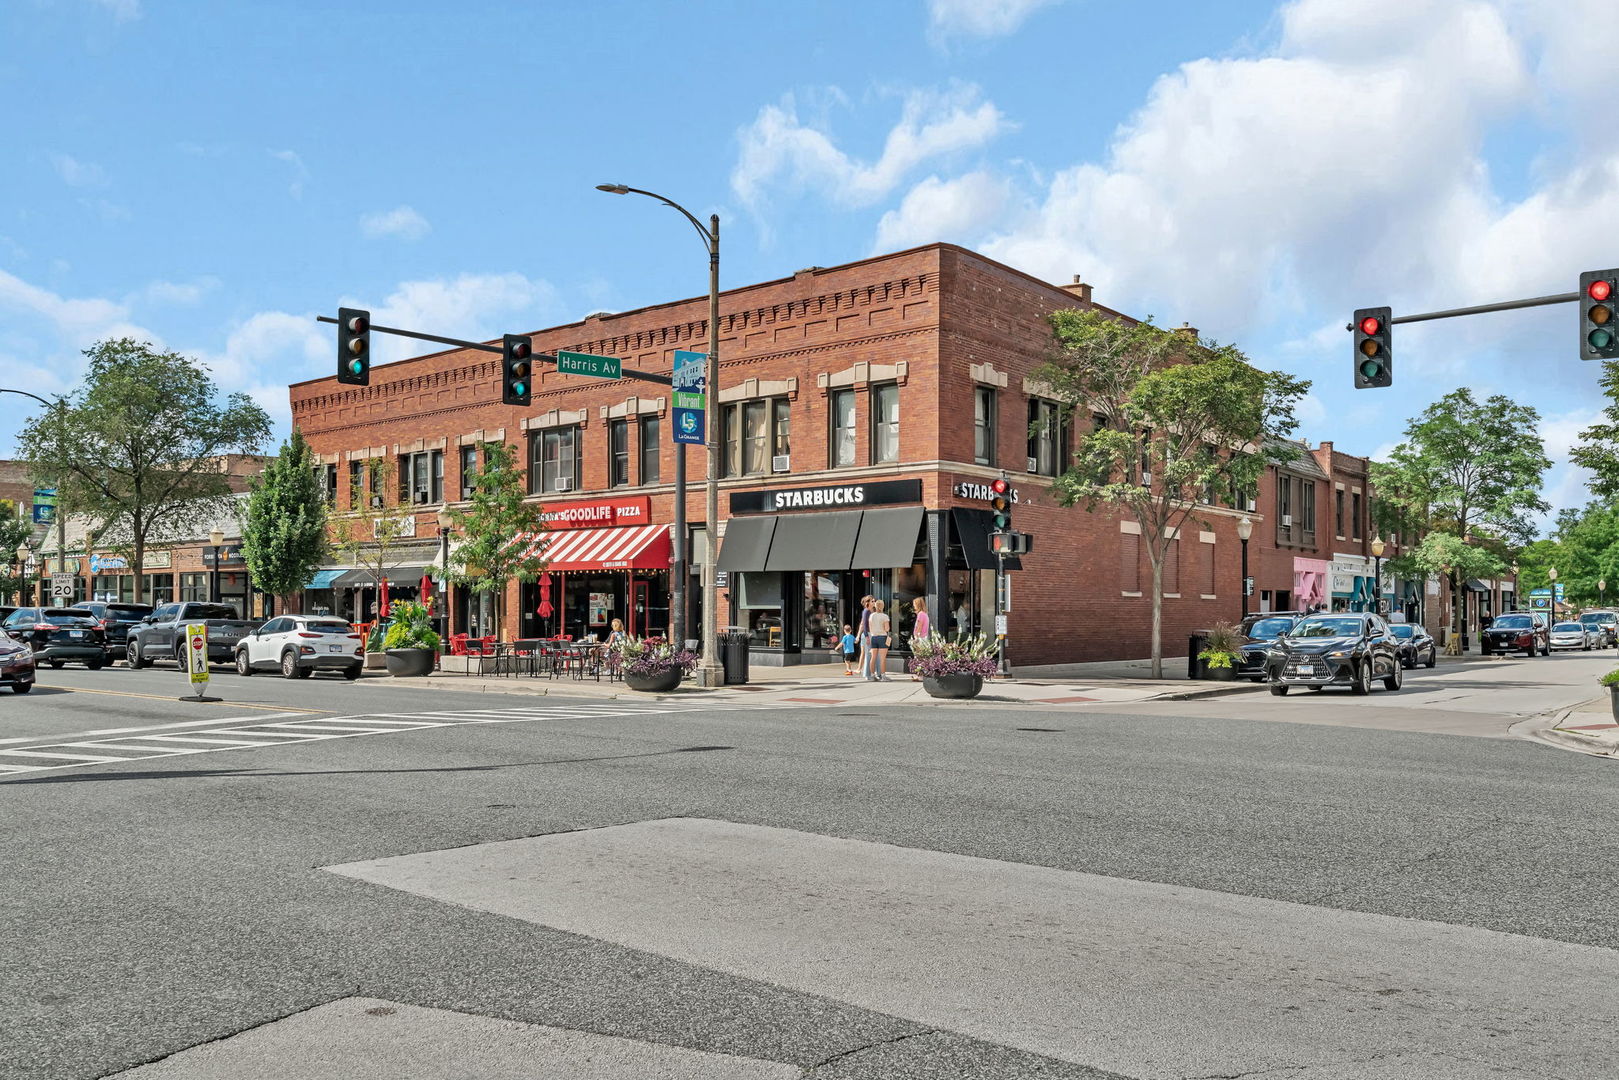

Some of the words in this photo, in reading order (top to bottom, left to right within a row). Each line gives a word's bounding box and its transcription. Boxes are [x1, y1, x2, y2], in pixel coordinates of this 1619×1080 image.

[562, 356, 597, 372] Harris
[602, 361, 617, 374] Av
[678, 393, 700, 408] Vibrant
[775, 486, 864, 508] STARBUCKS
[961, 482, 1019, 504] STARBKS
[564, 506, 611, 521] GOODLIFE
[616, 506, 640, 517] PIZZA
[54, 586, 72, 596] 20
